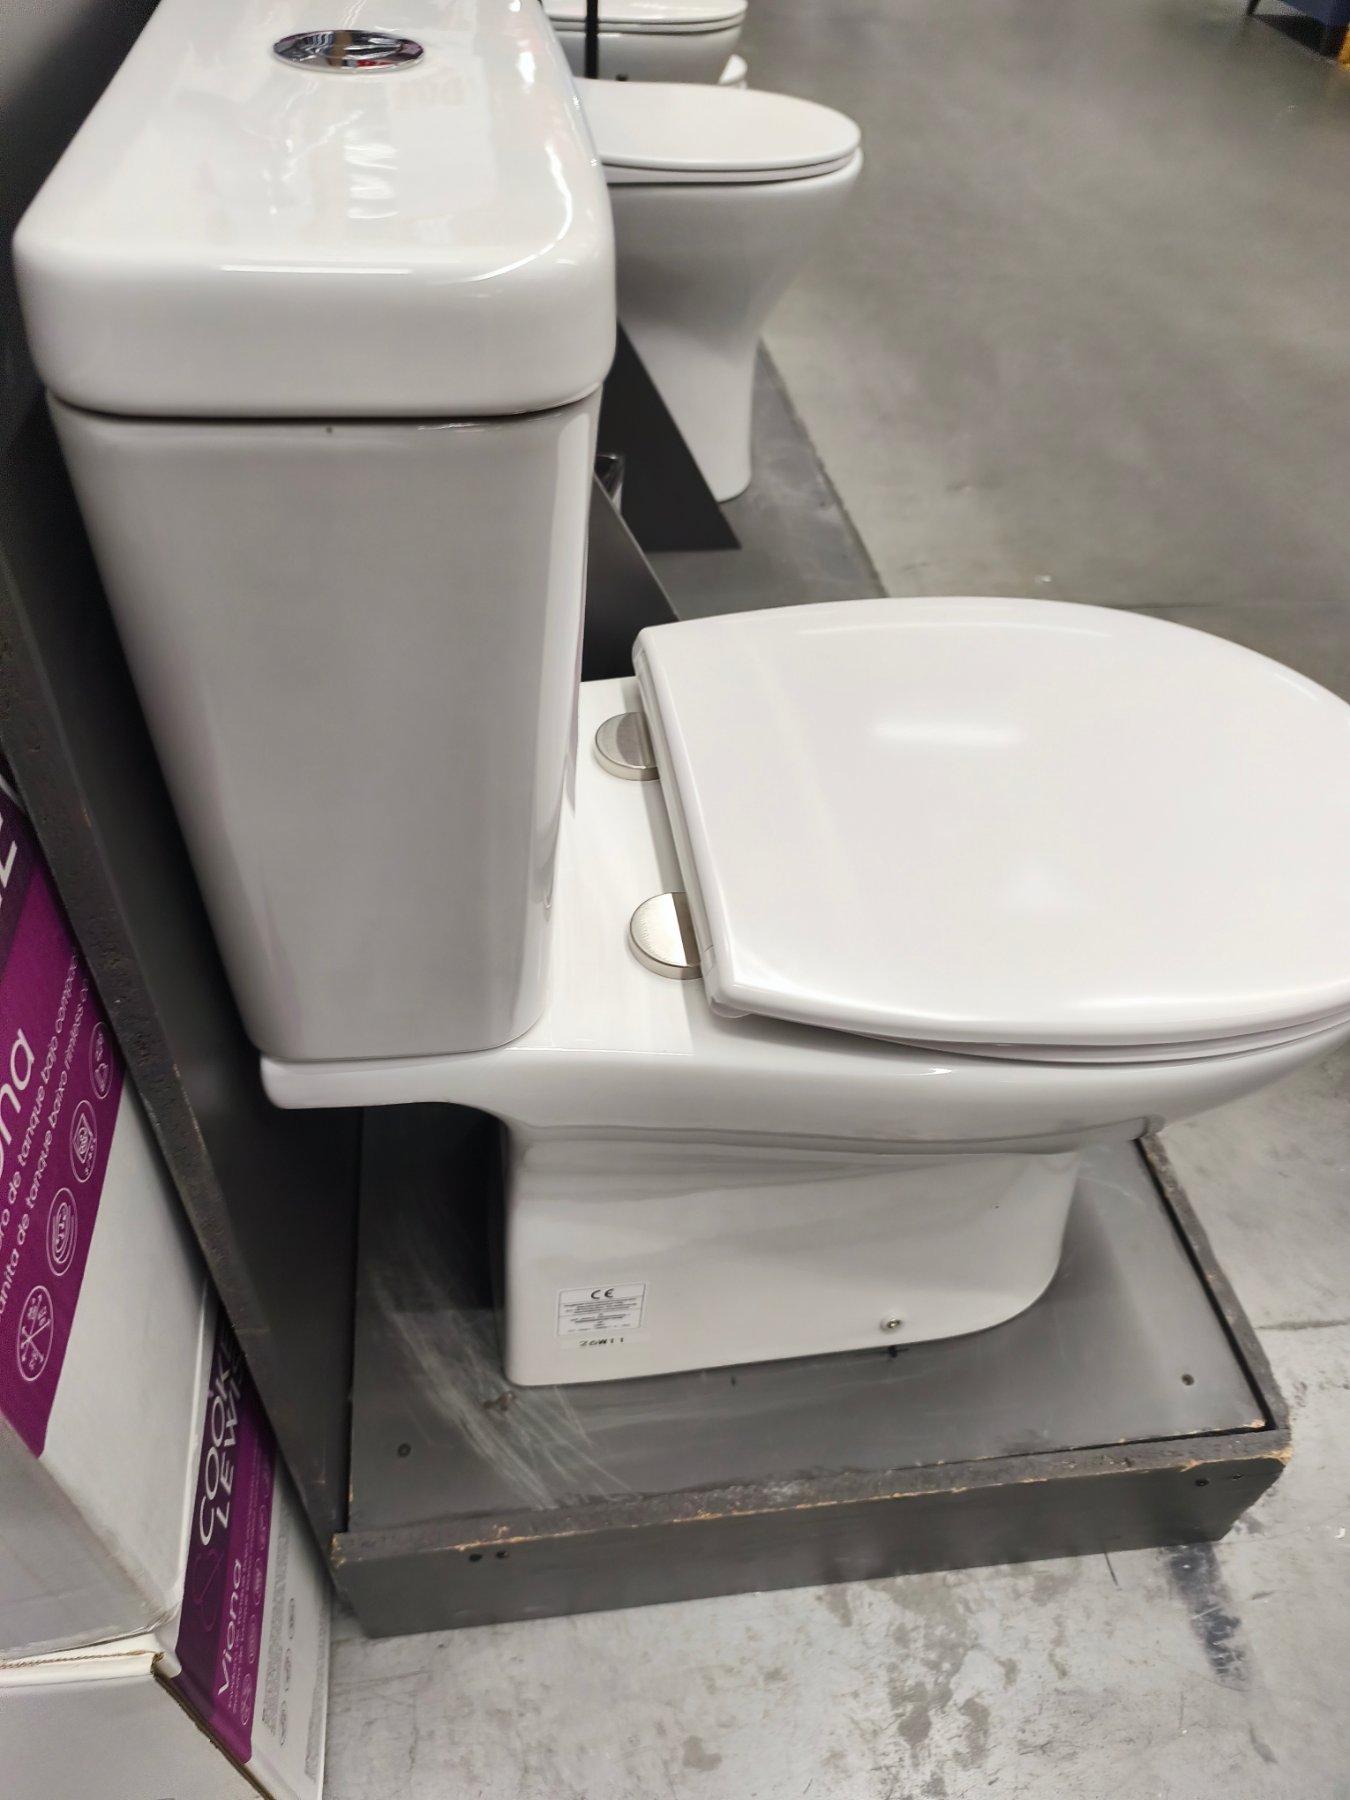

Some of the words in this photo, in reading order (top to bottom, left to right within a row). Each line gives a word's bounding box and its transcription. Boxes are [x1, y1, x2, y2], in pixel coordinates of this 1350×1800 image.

[8, 1170, 21, 1205] de
[18, 1085, 46, 1167] tanque
[17, 1213, 30, 1246] de
[26, 1129, 53, 1208] tanque
[217, 1558, 242, 1696] Viona
